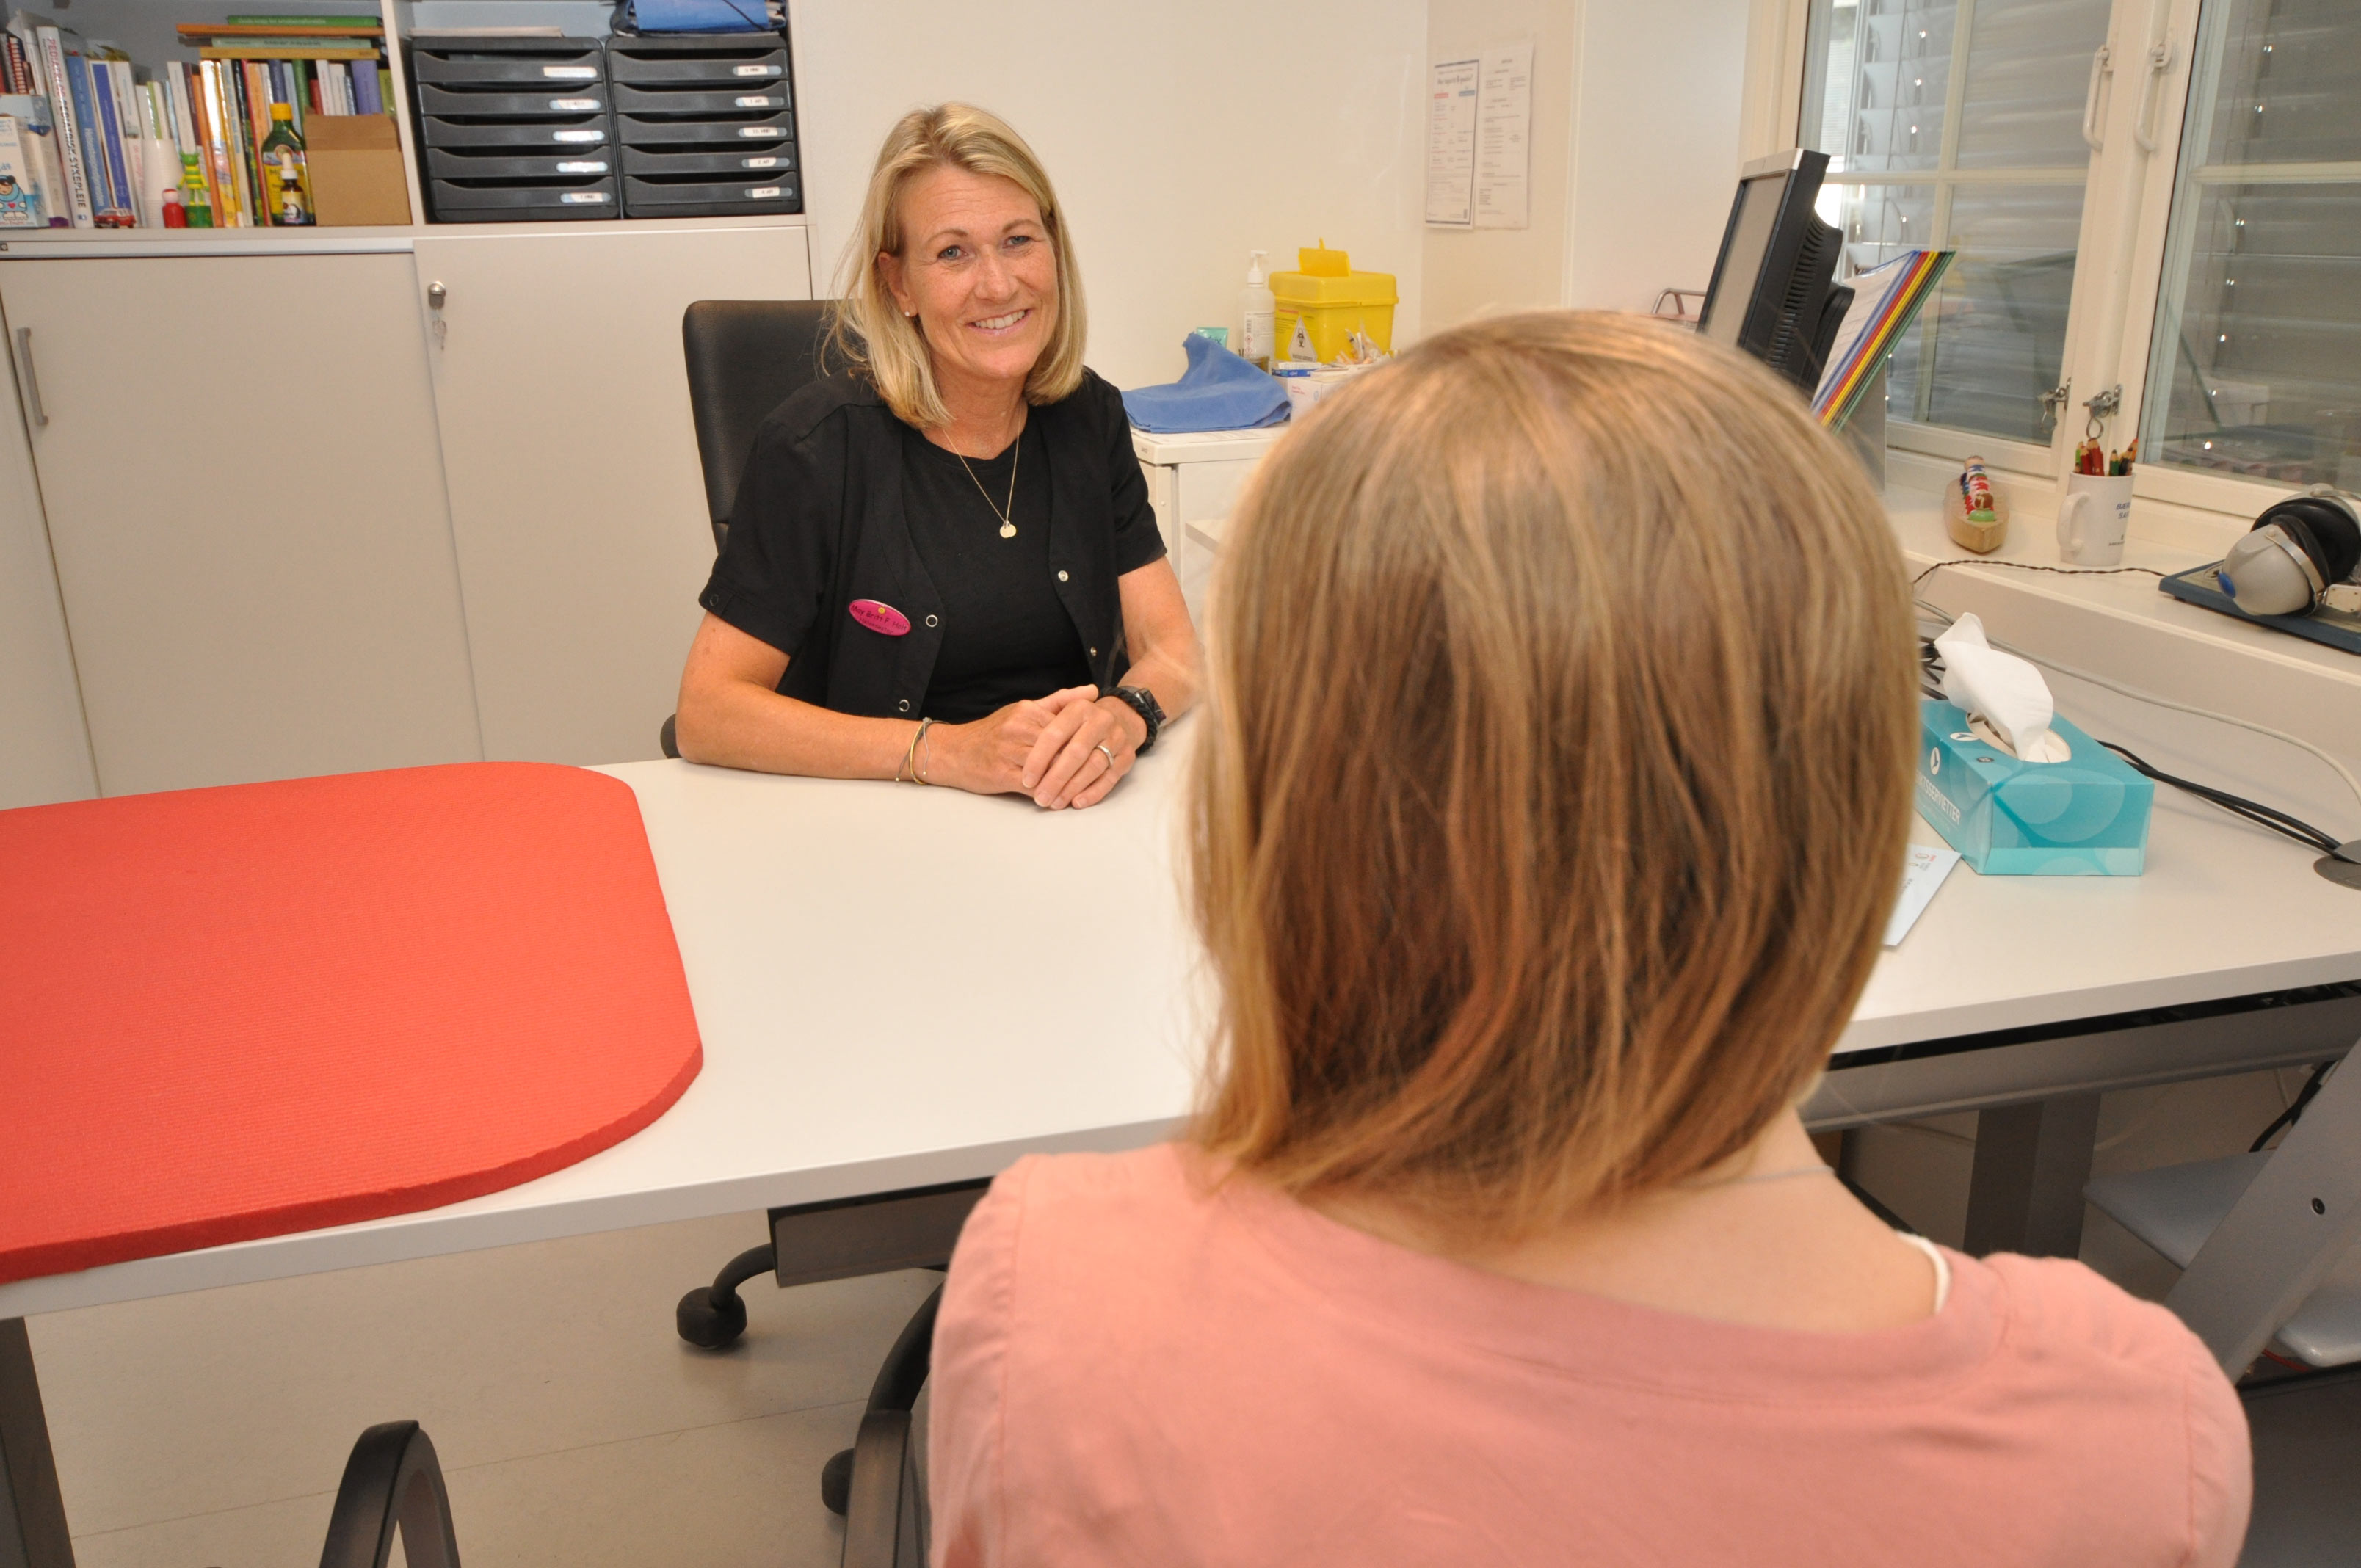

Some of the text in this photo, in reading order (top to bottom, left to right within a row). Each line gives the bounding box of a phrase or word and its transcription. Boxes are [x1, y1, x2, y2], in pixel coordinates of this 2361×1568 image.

[47, 37, 63, 83] PEDIATRI
[59, 99, 77, 155] PEDIATRISK
[69, 156, 87, 208] SYKEPLEIE
[851, 604, 866, 617] May
[866, 611, 883, 621] Britt
[1916, 769, 1962, 826] KTSSERVIETTER
